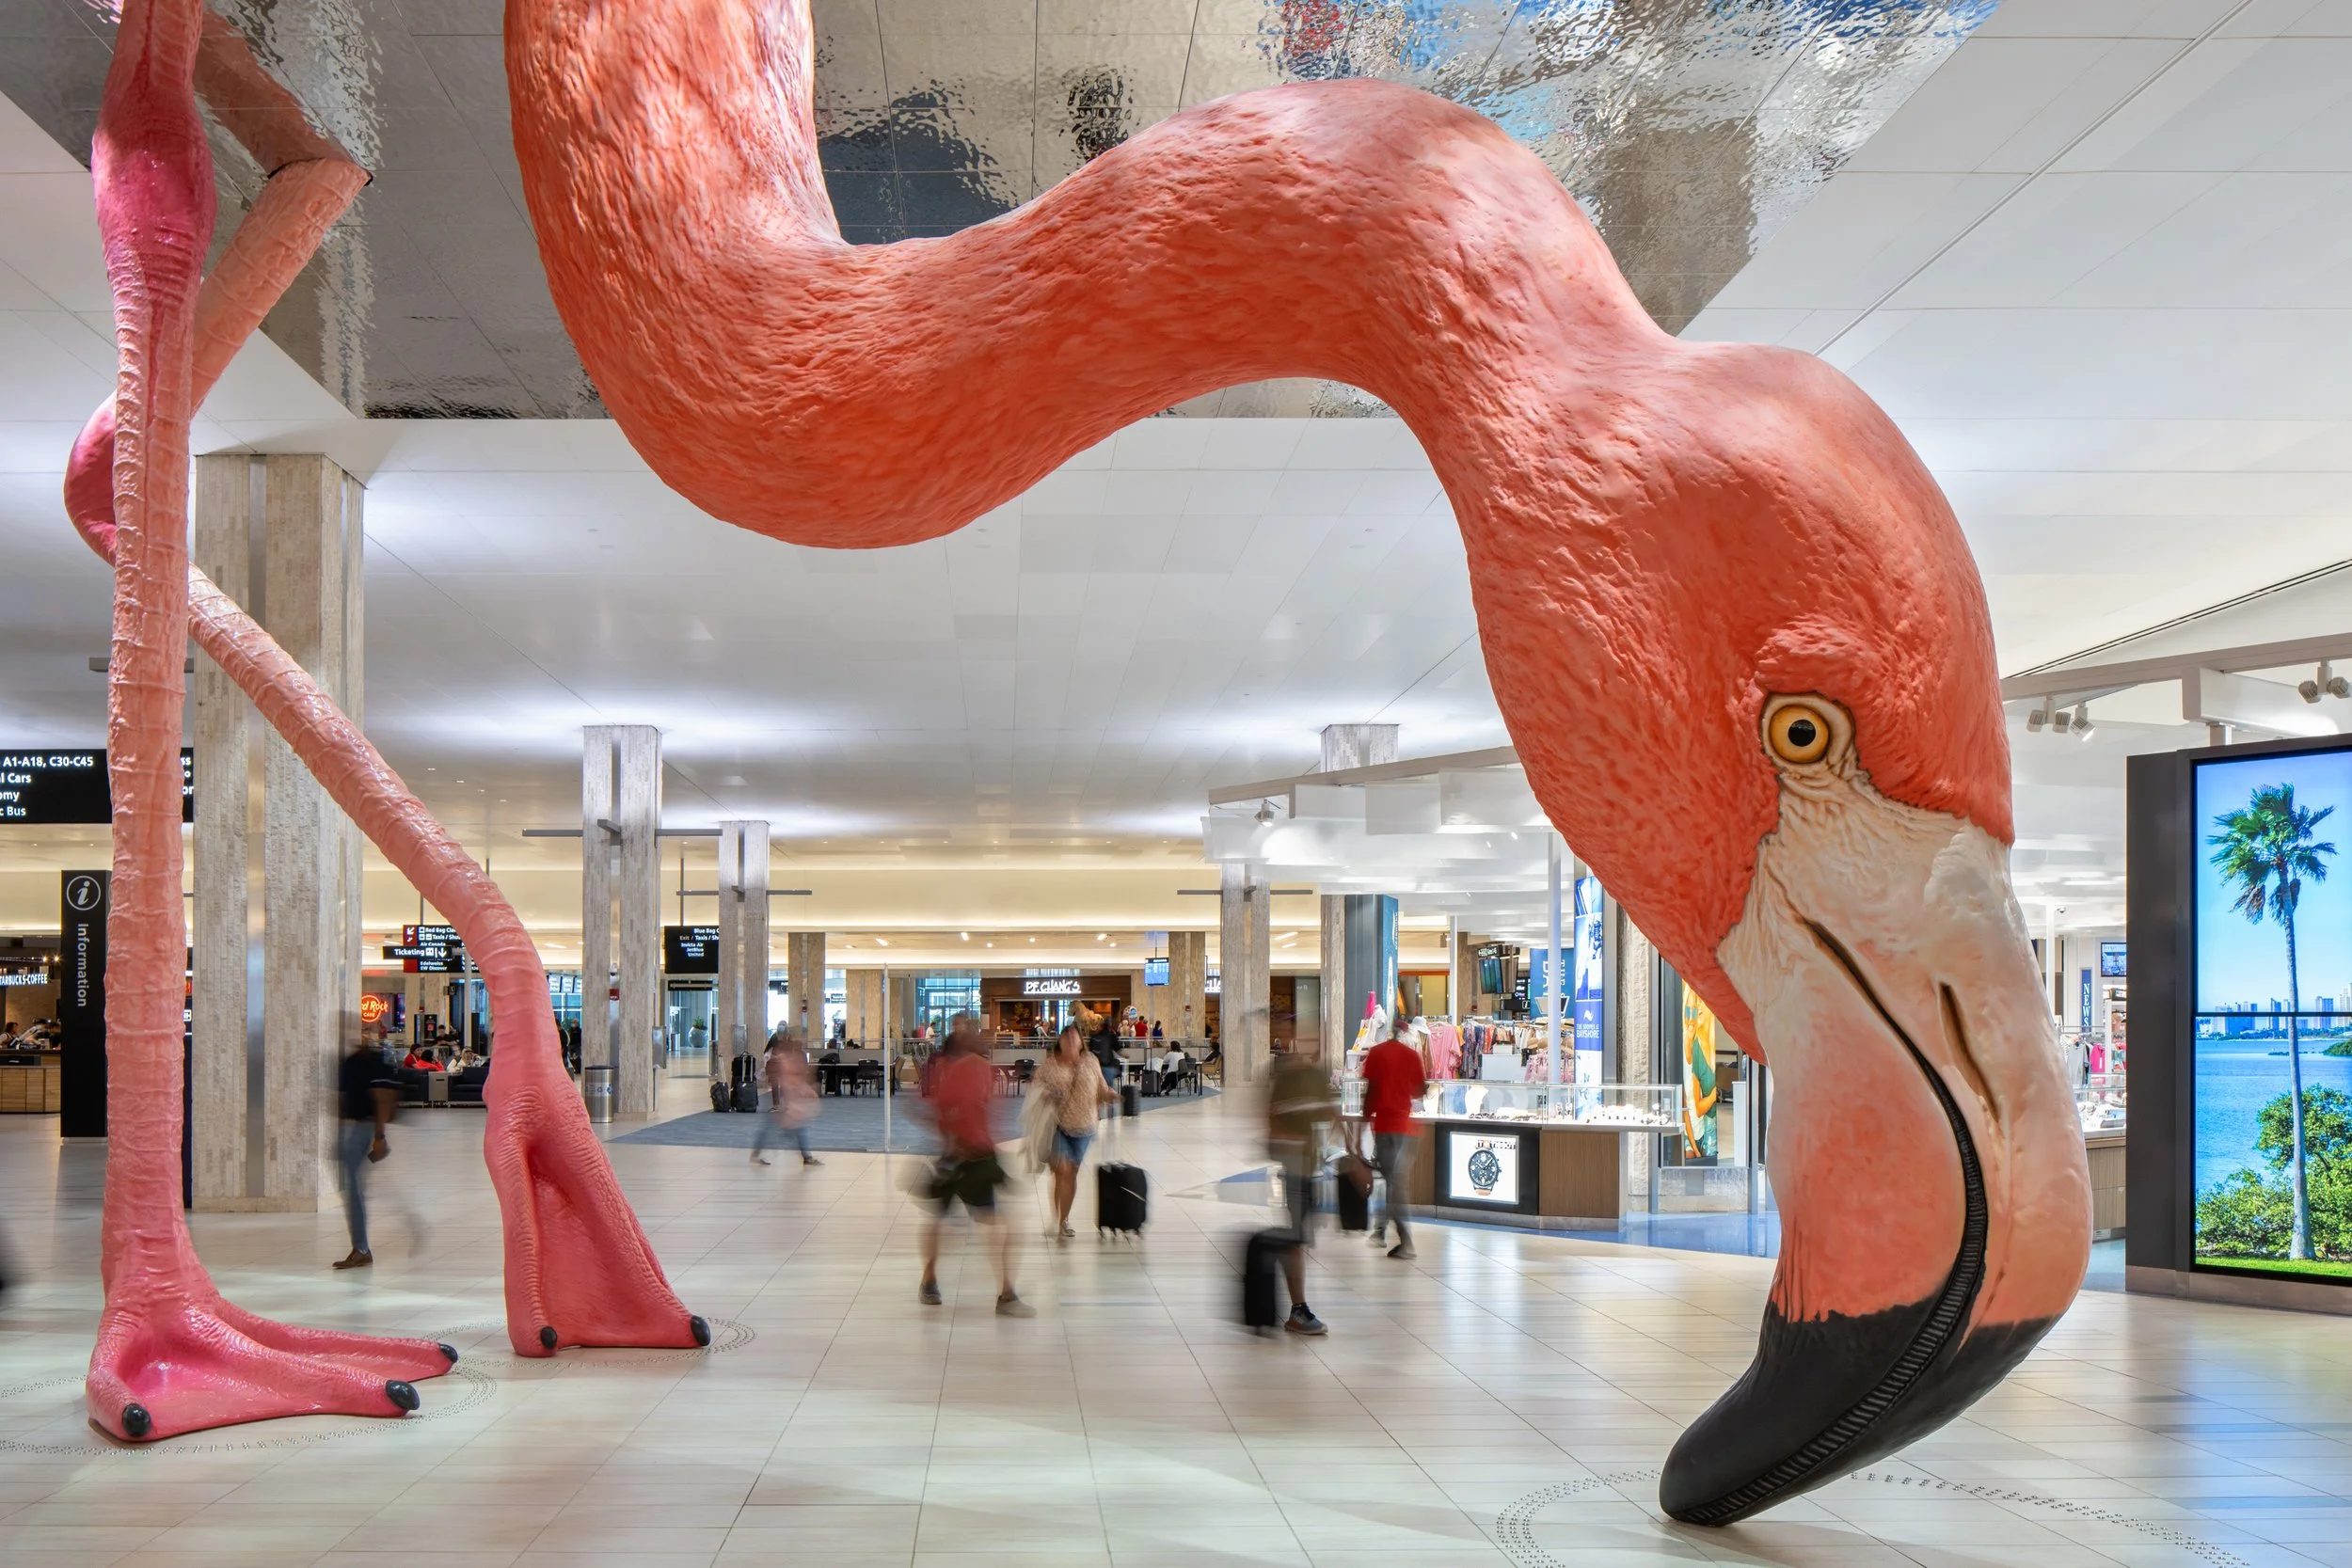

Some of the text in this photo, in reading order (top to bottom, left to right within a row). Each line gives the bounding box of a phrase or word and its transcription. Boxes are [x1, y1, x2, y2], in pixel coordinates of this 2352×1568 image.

[3, 756, 93, 768] A1-A18, C30-C45
[8, 773, 31, 783] Cars
[7, 806, 26, 816] Bus
[394, 948, 424, 957] Ticketing
[77, 923, 89, 1007] Information
[370, 1000, 389, 1013] Rock
[2082, 983, 2090, 1027] NEWS
